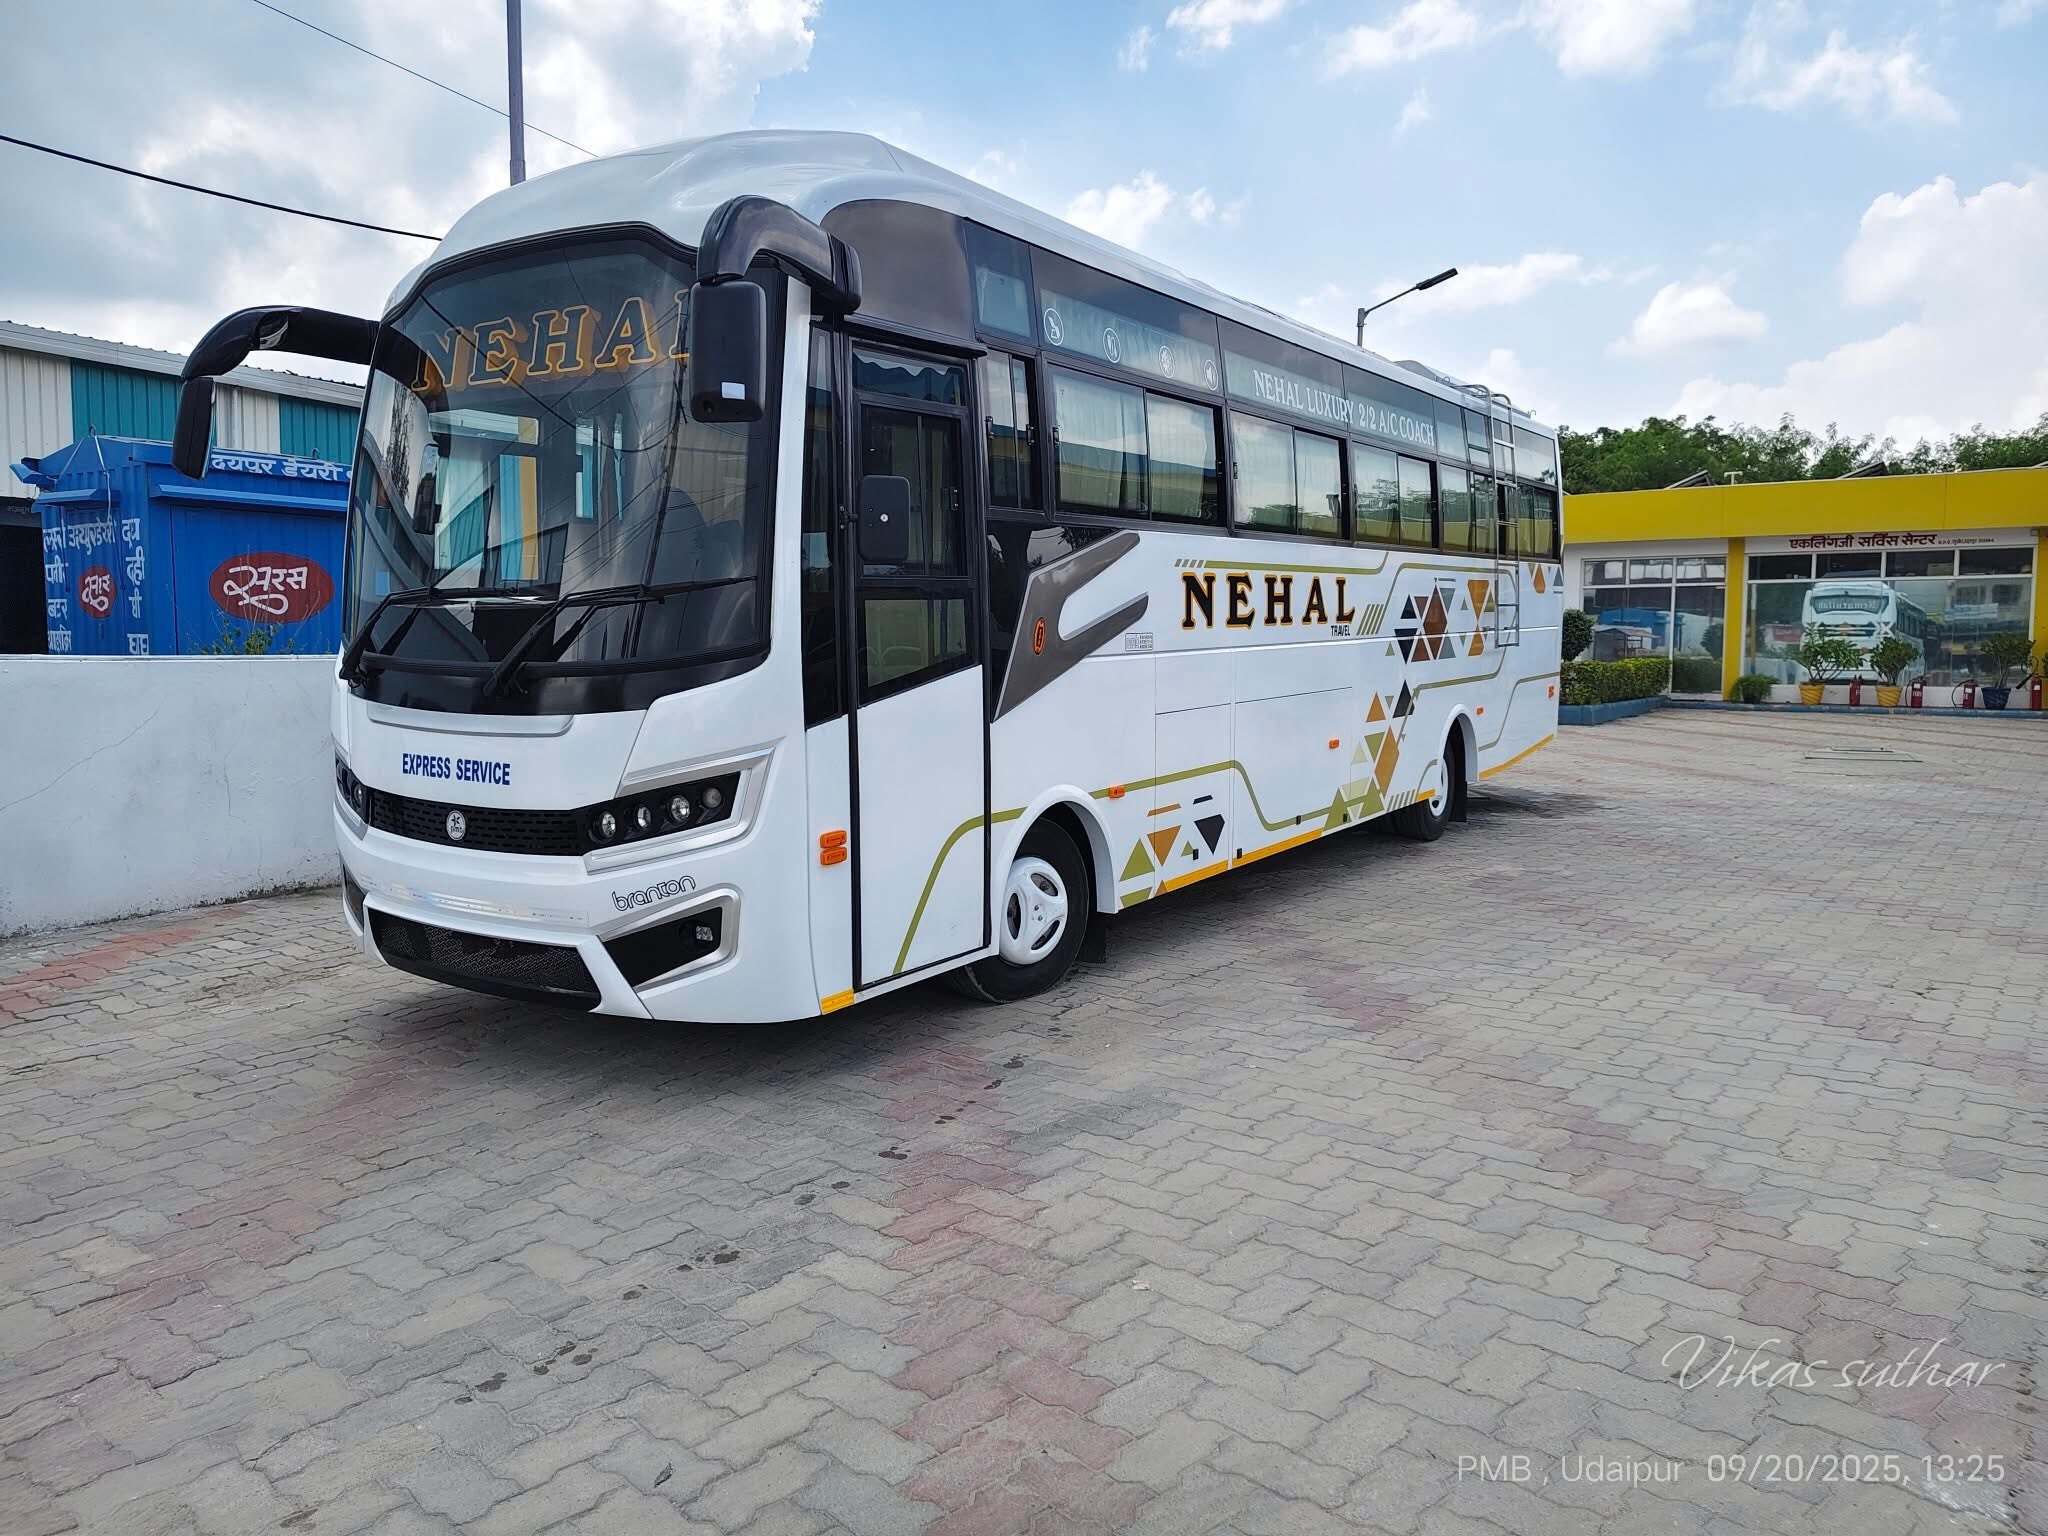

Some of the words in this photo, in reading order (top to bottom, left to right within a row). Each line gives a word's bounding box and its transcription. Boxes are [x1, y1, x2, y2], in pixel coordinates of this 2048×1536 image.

[1254, 369, 1304, 409] NEHAL
[1306, 386, 1354, 425] LUXURY
[1400, 415, 1435, 447] COACH
[1181, 571, 1356, 630] NEHAL
[1330, 624, 1351, 637] TRAVEL
[402, 753, 451, 780] EXPRESS
[456, 758, 511, 786] SERVICE
[611, 875, 697, 912] branton
